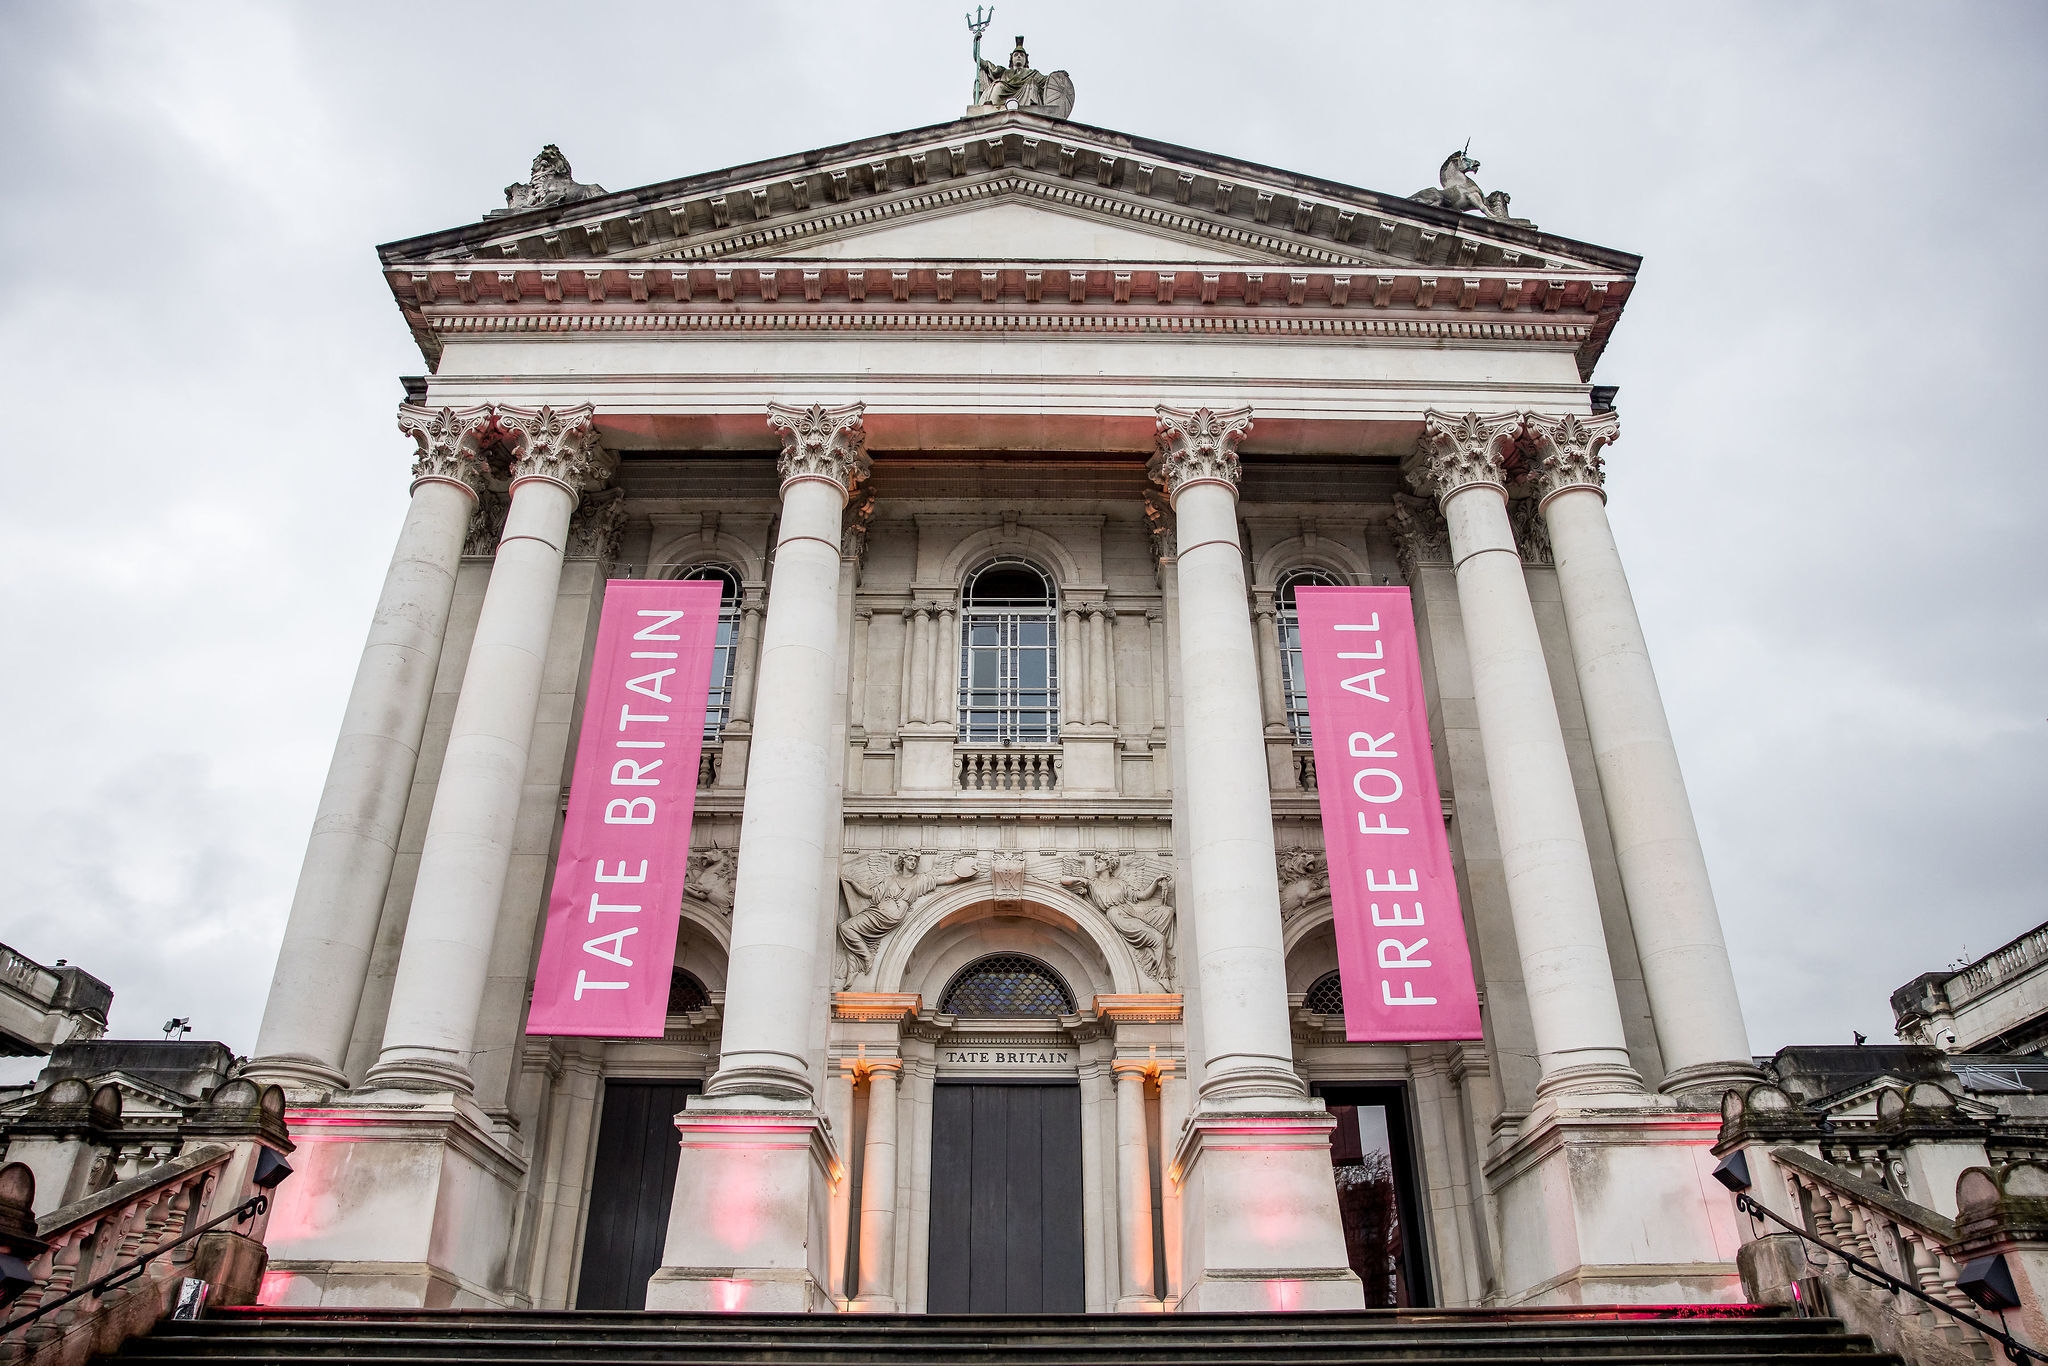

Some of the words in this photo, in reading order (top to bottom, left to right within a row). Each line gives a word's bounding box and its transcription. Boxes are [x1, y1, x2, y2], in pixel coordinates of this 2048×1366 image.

[603, 609, 685, 825] BRITAIN
[1332, 611, 1391, 703] ALL
[1347, 731, 1410, 835] FOR
[573, 859, 649, 1002] TATE
[1365, 867, 1438, 1006] FREE
[945, 1052, 990, 1063] TATE
[995, 1052, 1068, 1064] BRITAIN
